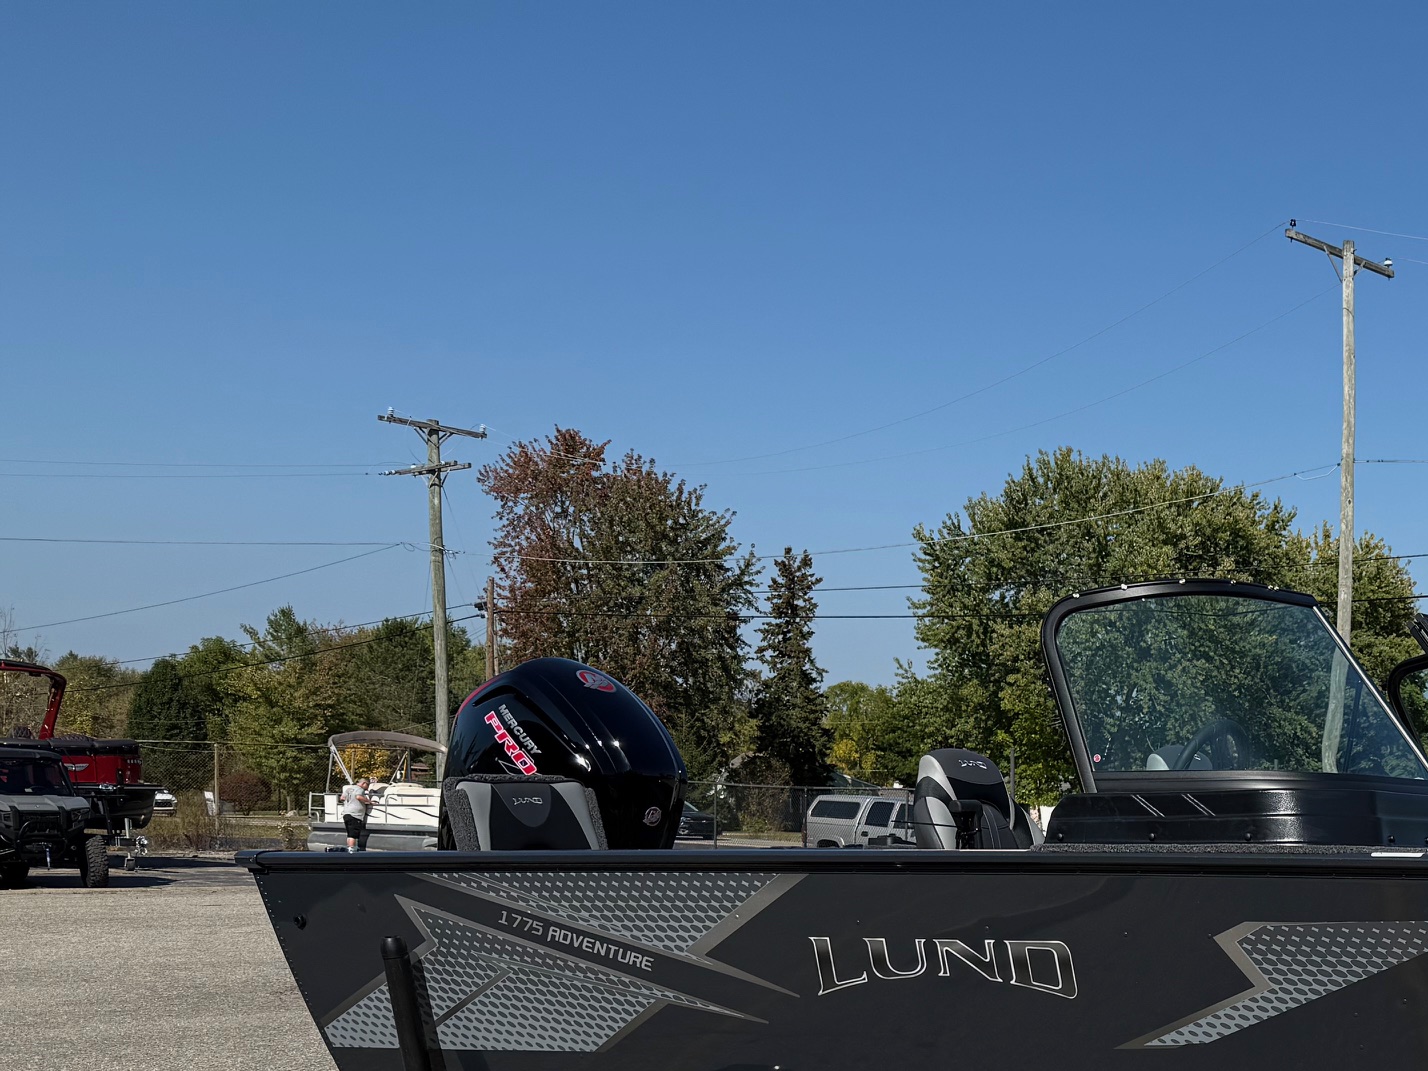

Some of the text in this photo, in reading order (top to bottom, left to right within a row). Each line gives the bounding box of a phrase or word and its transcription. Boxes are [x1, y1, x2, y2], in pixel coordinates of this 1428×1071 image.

[484, 711, 537, 775] PRO
[498, 704, 542, 754] MERCURY
[498, 910, 655, 972] 1775 ADVENTURE
[808, 936, 1077, 999] LUND
